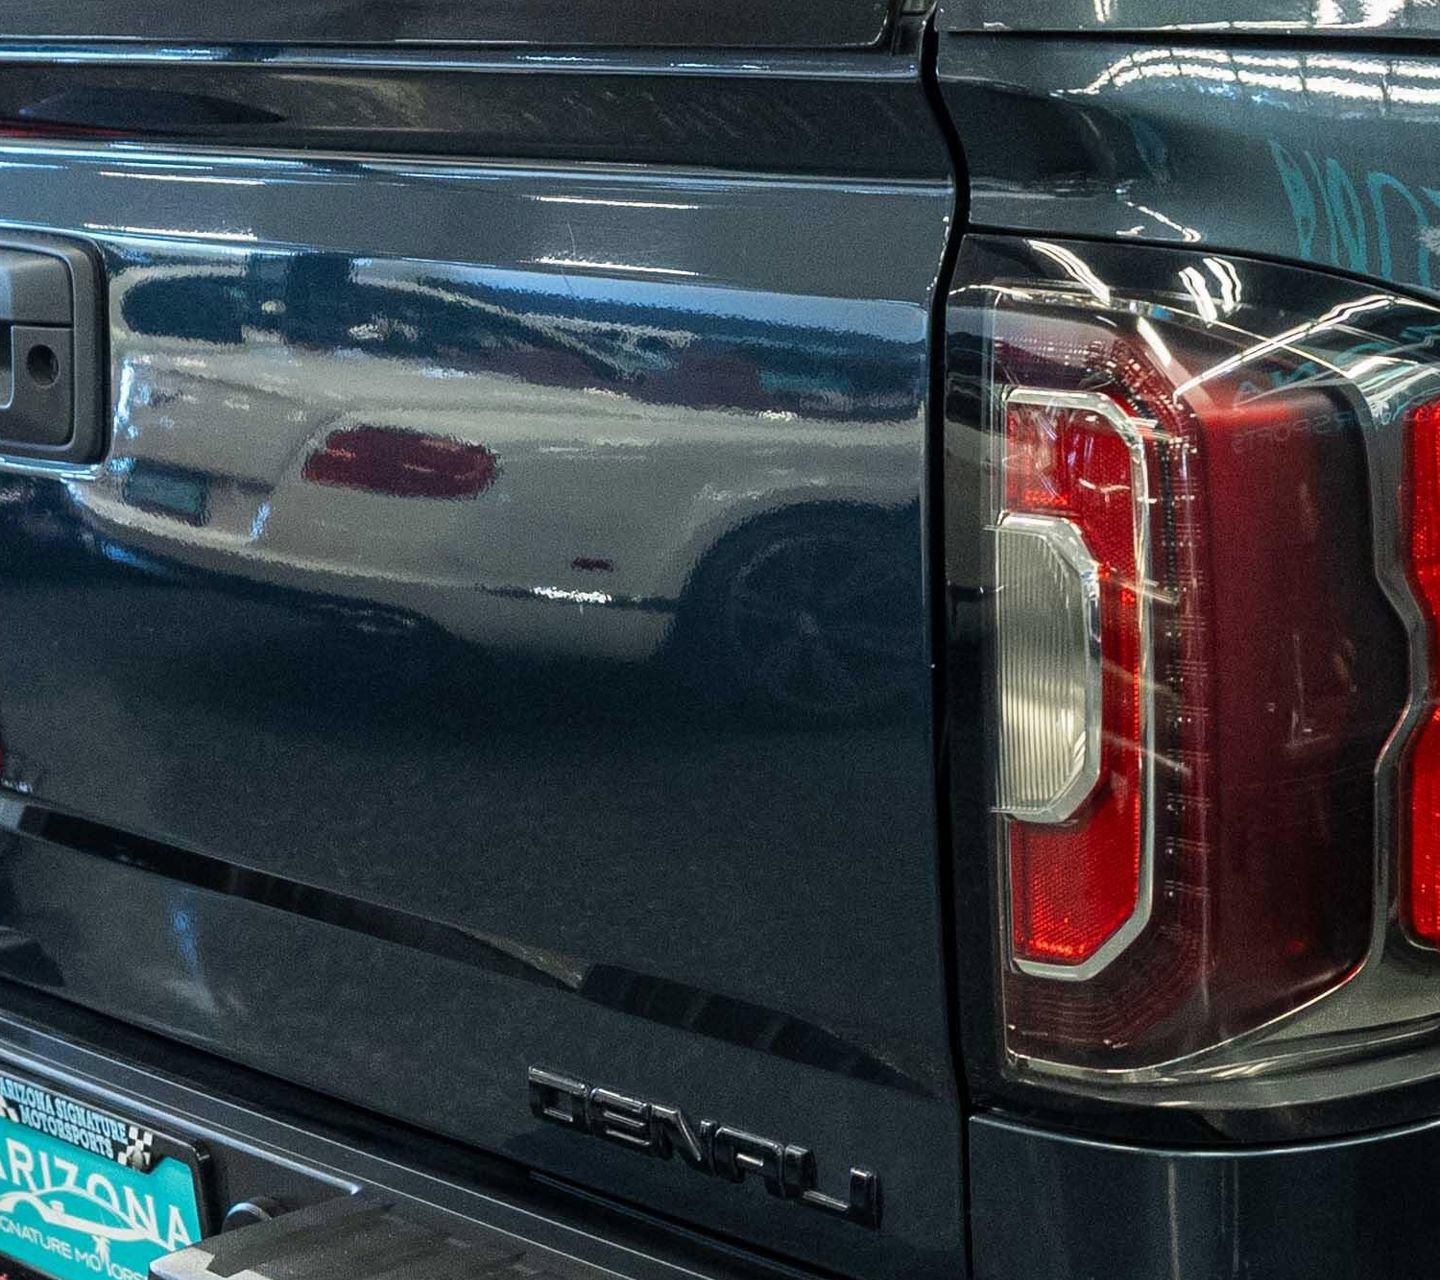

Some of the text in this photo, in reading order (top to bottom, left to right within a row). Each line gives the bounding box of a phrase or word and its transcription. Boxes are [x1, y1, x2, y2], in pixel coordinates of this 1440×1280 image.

[0, 1076, 128, 1144] ARIZONA SIGNATURE
[19, 1105, 114, 1158] MOTORSPORTS
[528, 1067, 883, 1228] DENALI
